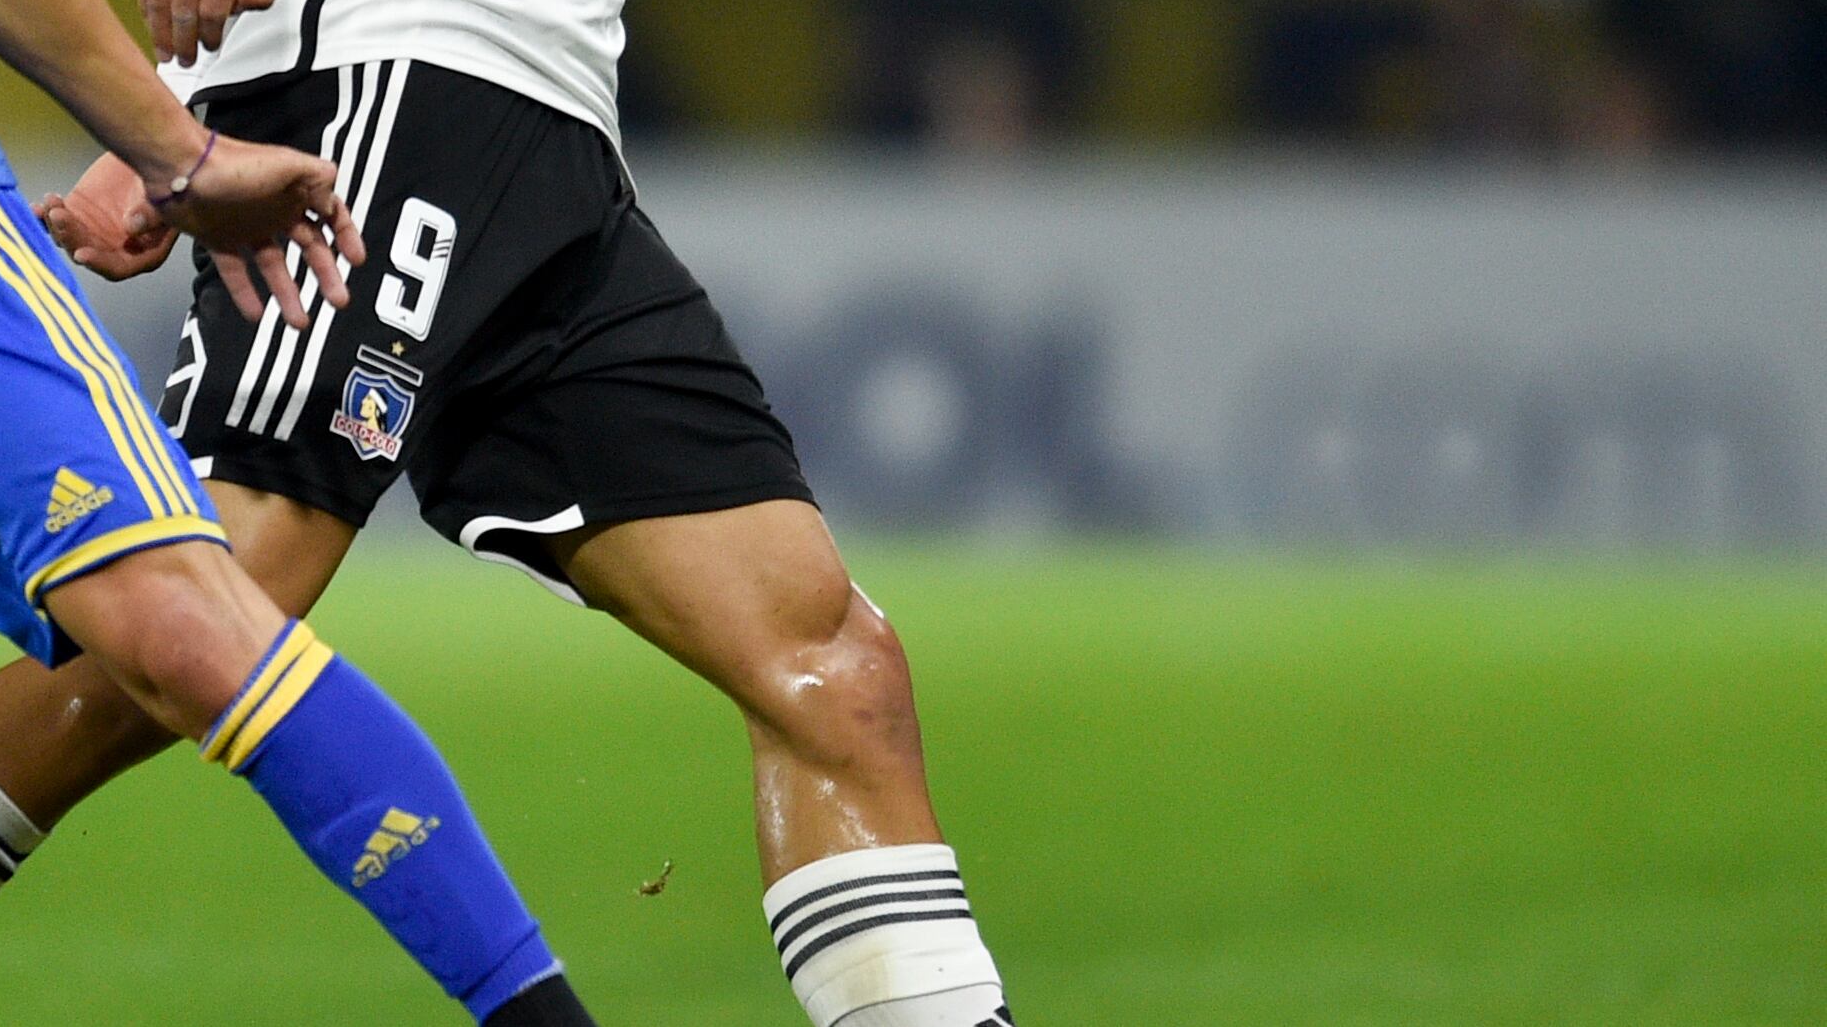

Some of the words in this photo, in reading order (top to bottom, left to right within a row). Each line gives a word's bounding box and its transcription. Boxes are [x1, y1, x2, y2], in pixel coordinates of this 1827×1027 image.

[374, 196, 458, 342] 9
[335, 416, 396, 455] COLO-COLO
[44, 484, 114, 534] adidas
